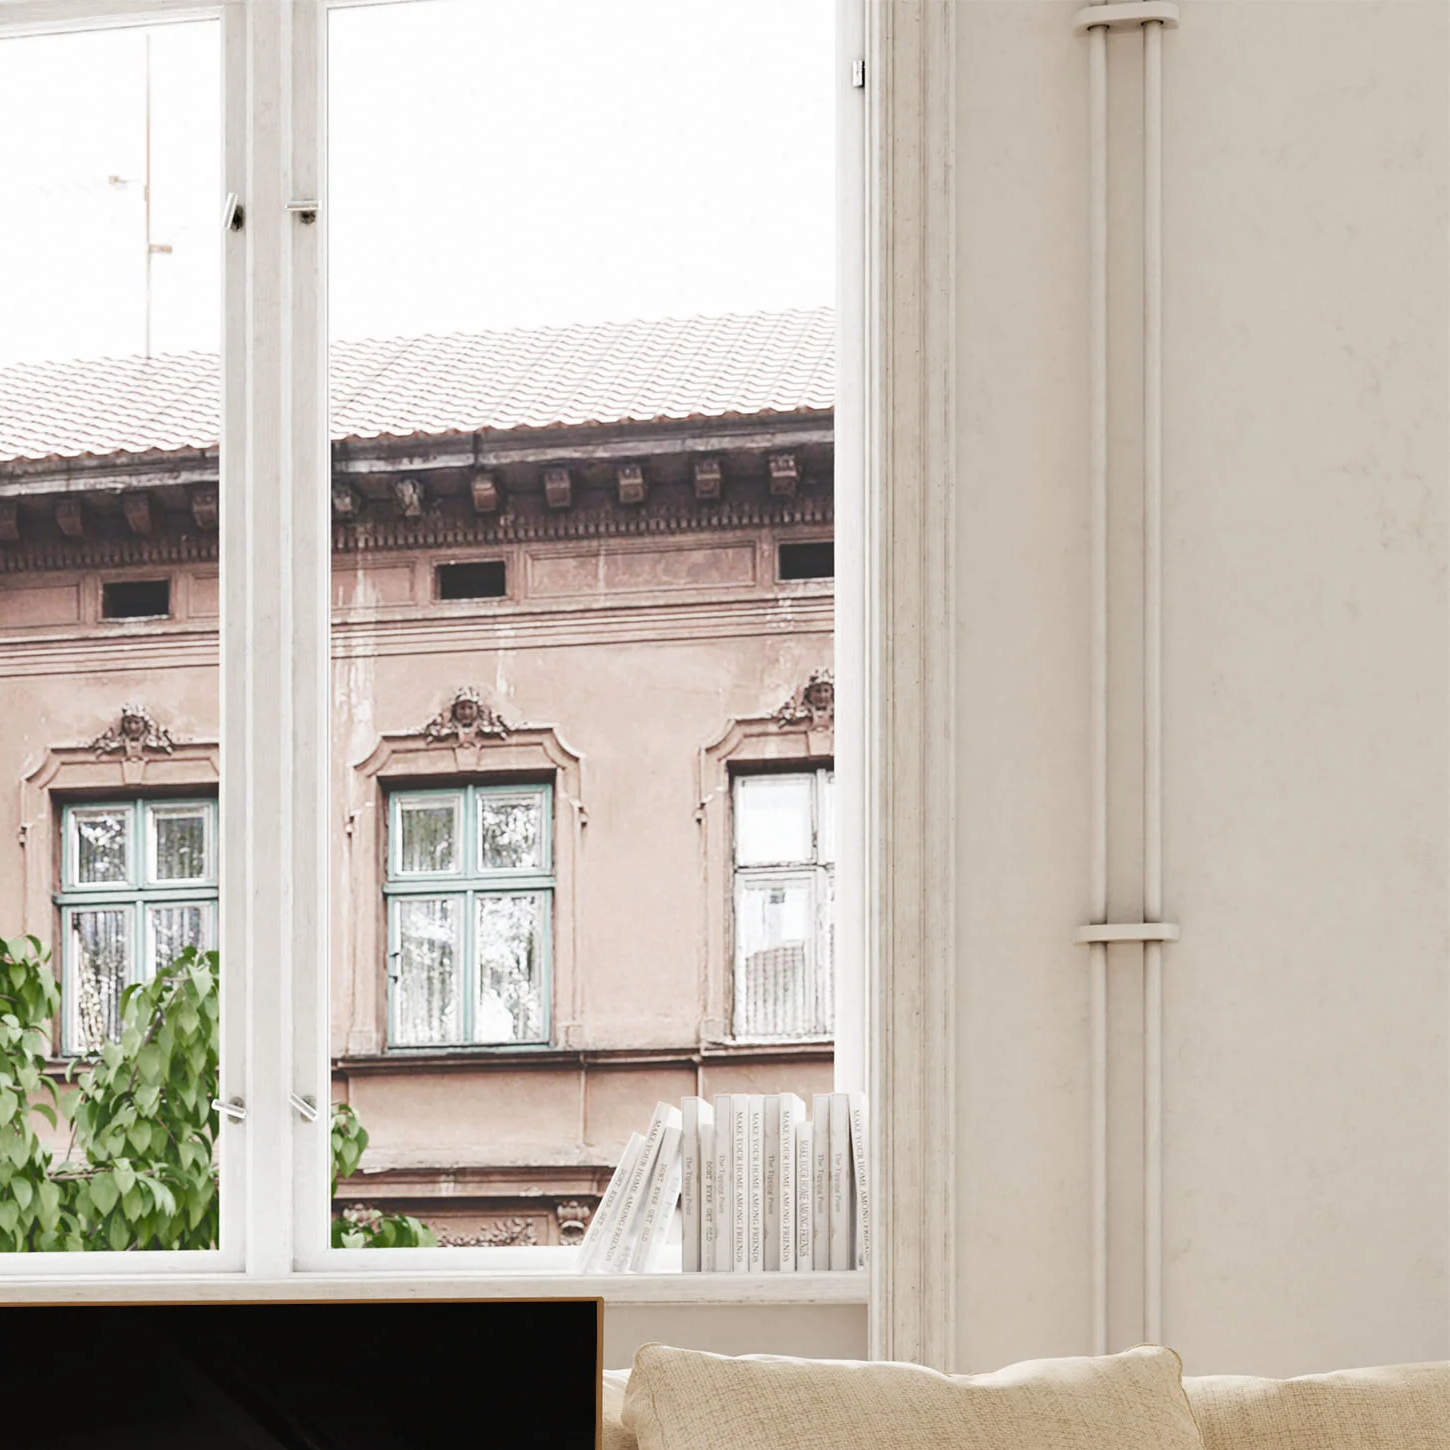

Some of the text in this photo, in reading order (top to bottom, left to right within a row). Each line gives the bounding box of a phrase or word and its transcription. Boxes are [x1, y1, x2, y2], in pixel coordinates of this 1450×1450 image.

[648, 1119, 662, 1143] MAKE
[853, 1109, 861, 1134] MAKE
[640, 1144, 654, 1168] YOUR
[799, 1140, 809, 1160] MAKE
[855, 1136, 863, 1161] YOUR
[630, 1167, 645, 1194] HOME
[782, 1111, 790, 1263] MAKE YOUR HOME AMONG FRIENDS
[858, 1161, 866, 1187] HOME
[619, 1195, 633, 1227] AMONG
[860, 1189, 869, 1222] AMONG
[605, 1227, 624, 1263] FRIENDS
